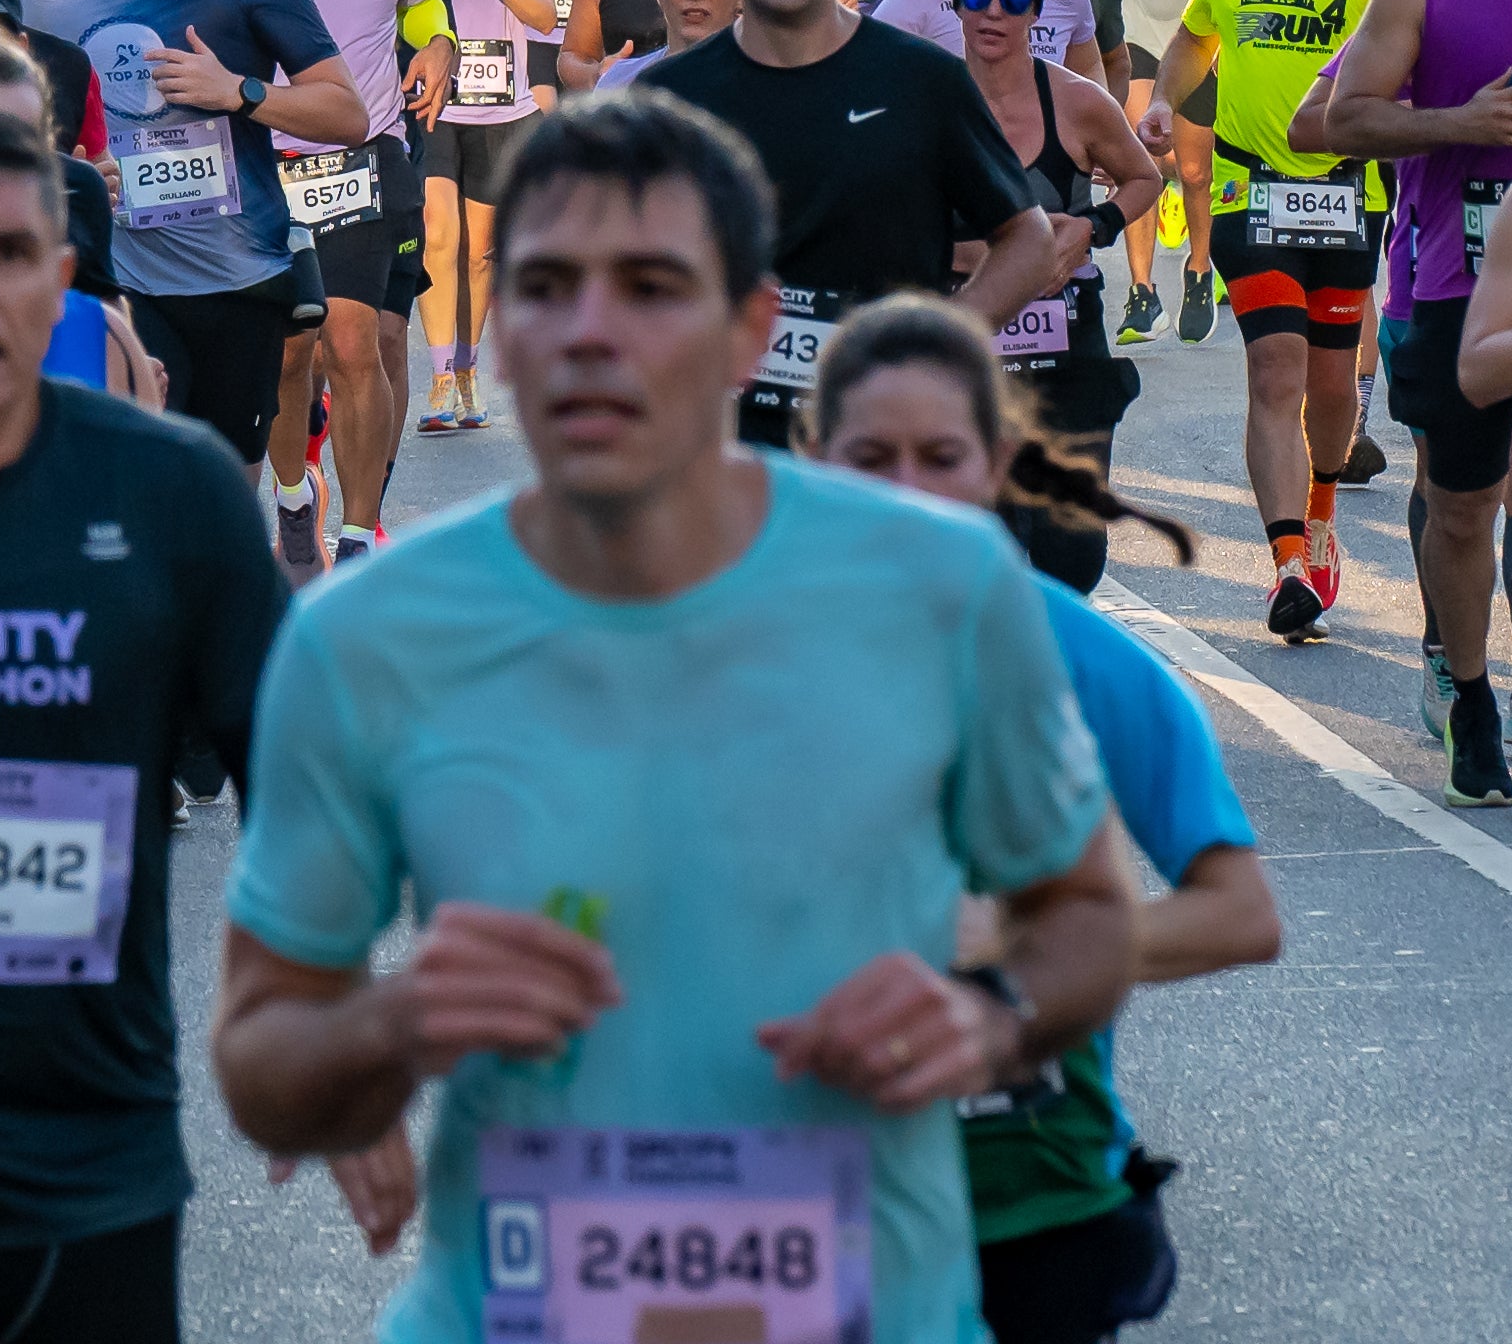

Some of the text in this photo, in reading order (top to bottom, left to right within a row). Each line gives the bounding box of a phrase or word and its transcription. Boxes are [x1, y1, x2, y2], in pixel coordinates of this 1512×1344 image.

[104, 70, 133, 84] TOP
[146, 128, 186, 141] SPCITY
[137, 155, 218, 187] 23381
[158, 188, 202, 202] GIULIANO
[303, 178, 360, 208] 6570
[1255, 189, 1266, 205] C
[1285, 191, 1348, 215] 8644
[1298, 219, 1336, 228] ROBERTO
[779, 288, 816, 304] CITY
[1002, 342, 1040, 352] ELISANE
[578, 1223, 821, 1294] 24848
